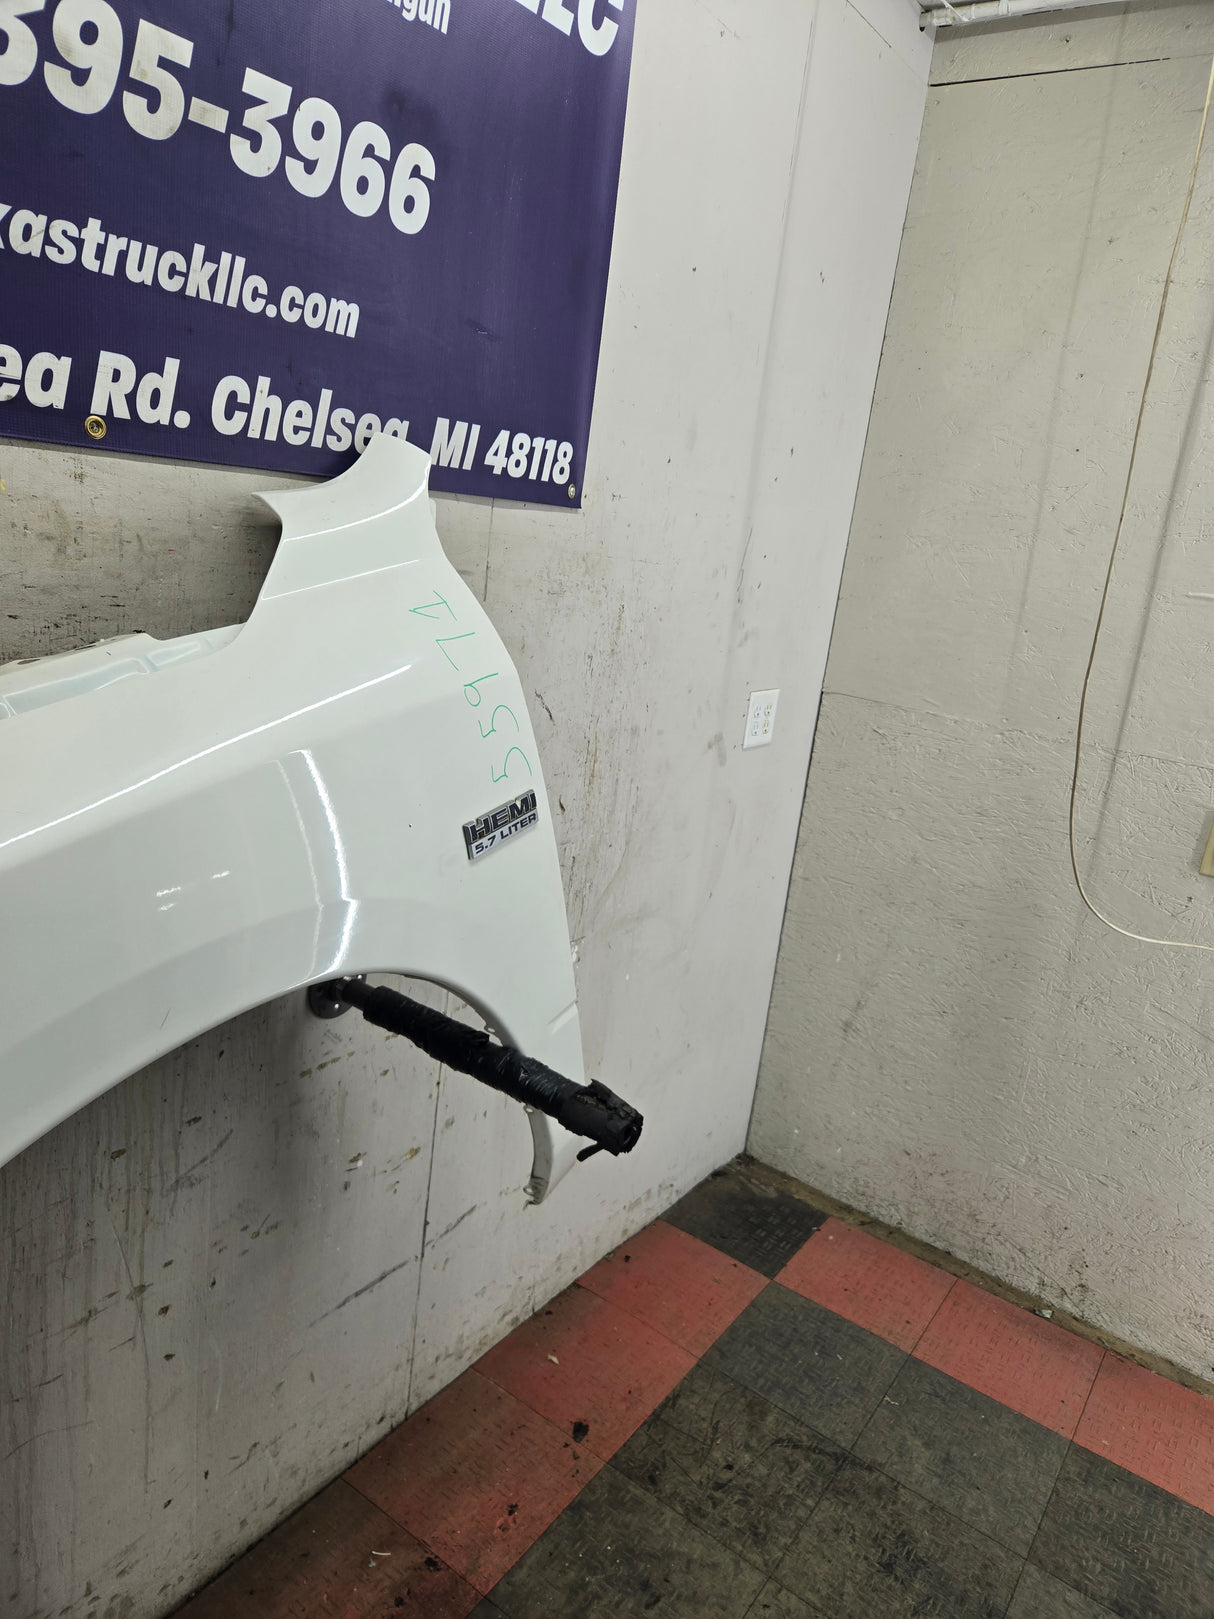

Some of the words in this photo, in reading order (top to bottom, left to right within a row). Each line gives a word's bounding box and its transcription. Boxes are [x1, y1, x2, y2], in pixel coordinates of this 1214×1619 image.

[90, 350, 191, 429] Rd.
[430, 416, 481, 471] MI
[484, 429, 574, 485] 48118
[468, 791, 537, 843] HEMI
[475, 834, 497, 854] 5.7
[500, 812, 537, 840] LITER
